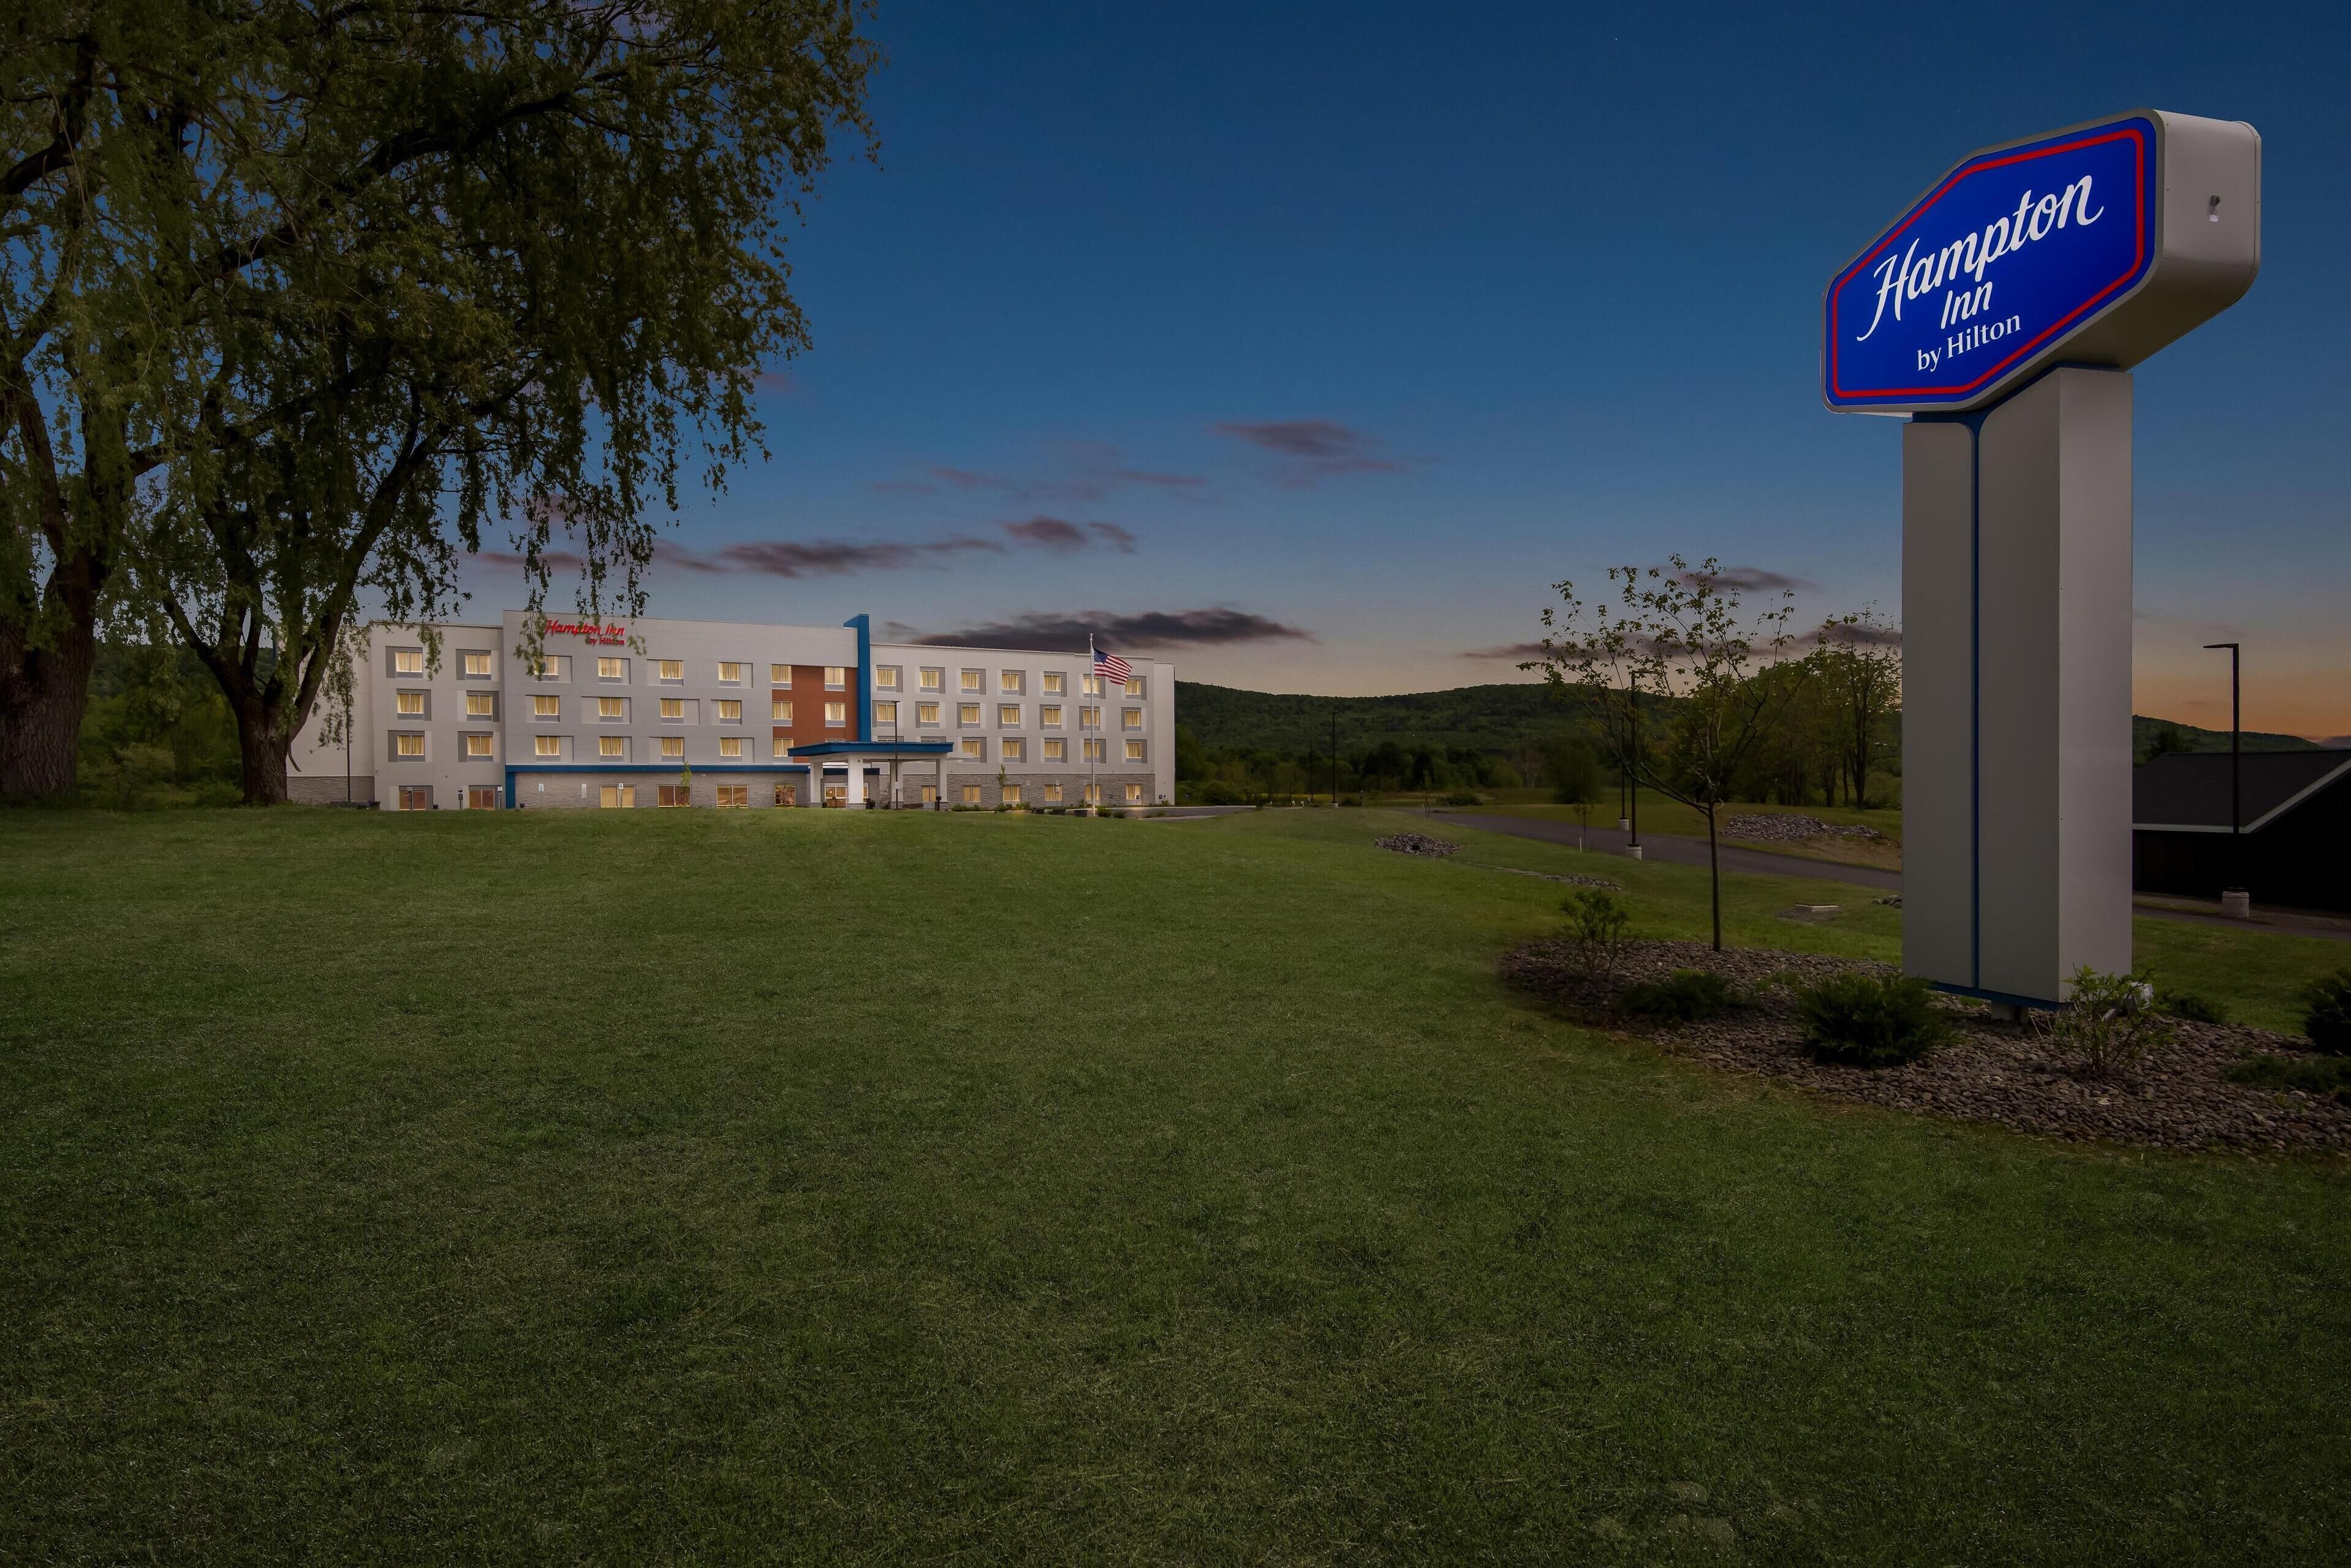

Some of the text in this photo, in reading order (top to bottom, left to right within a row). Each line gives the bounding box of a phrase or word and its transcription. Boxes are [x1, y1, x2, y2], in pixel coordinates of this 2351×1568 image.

[1857, 175, 2103, 341] Hampton
[1940, 281, 1993, 330] Inn
[1917, 315, 2021, 371] by Hilton
[605, 624, 625, 635] Inn
